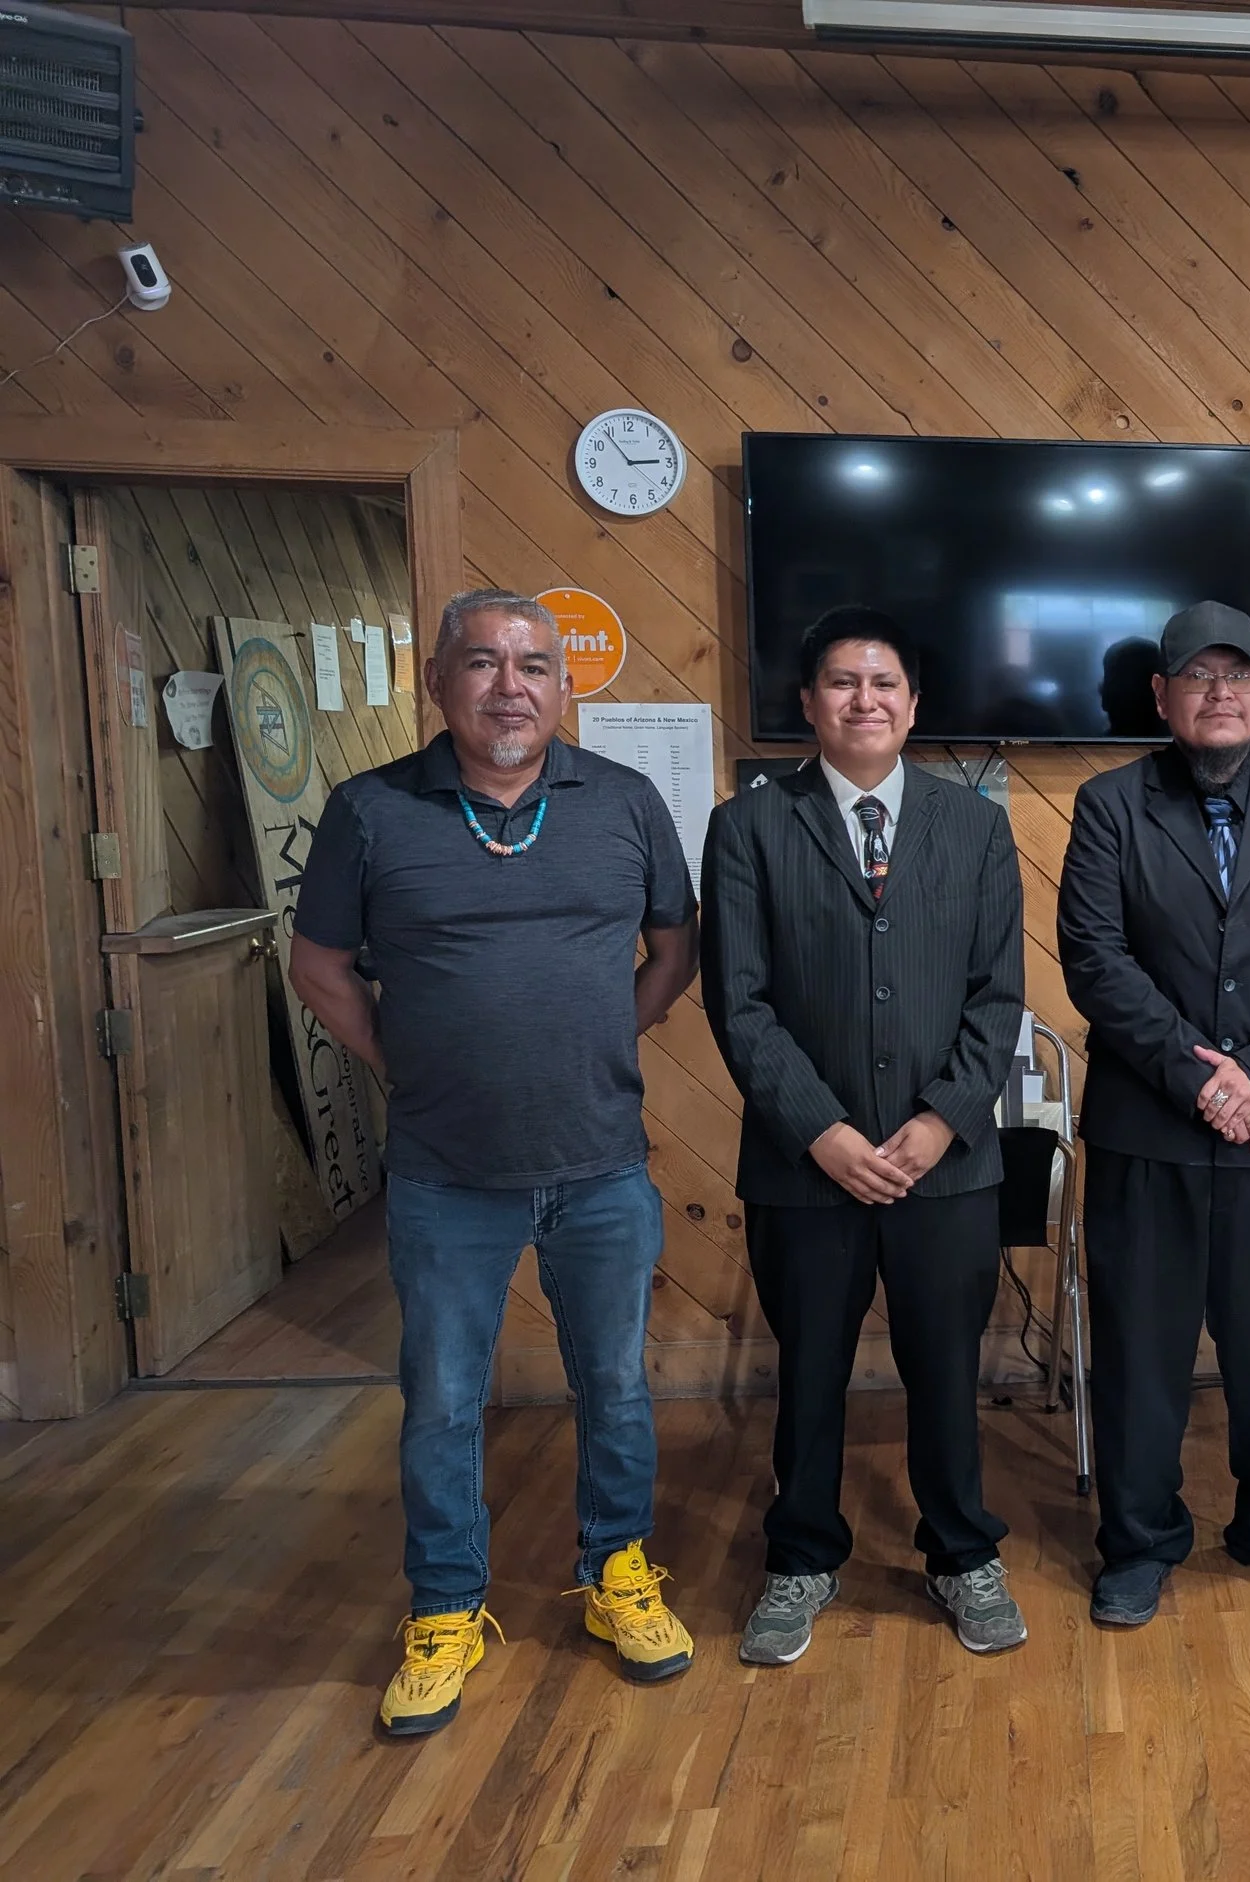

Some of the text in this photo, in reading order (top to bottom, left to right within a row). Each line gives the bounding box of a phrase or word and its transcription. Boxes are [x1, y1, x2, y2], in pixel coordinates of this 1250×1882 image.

[623, 421, 634, 432] 12
[645, 426, 649, 437] 1
[594, 440, 605, 451] 10
[658, 439, 666, 450] 2
[589, 457, 597, 469] 9
[665, 457, 673, 468] 3
[596, 476, 604, 487] 8
[660, 476, 668, 487] 4
[611, 489, 618, 500] 7
[629, 494, 637, 505] 6
[647, 489, 655, 500] 5
[342, 1044, 369, 1193] ooperative
